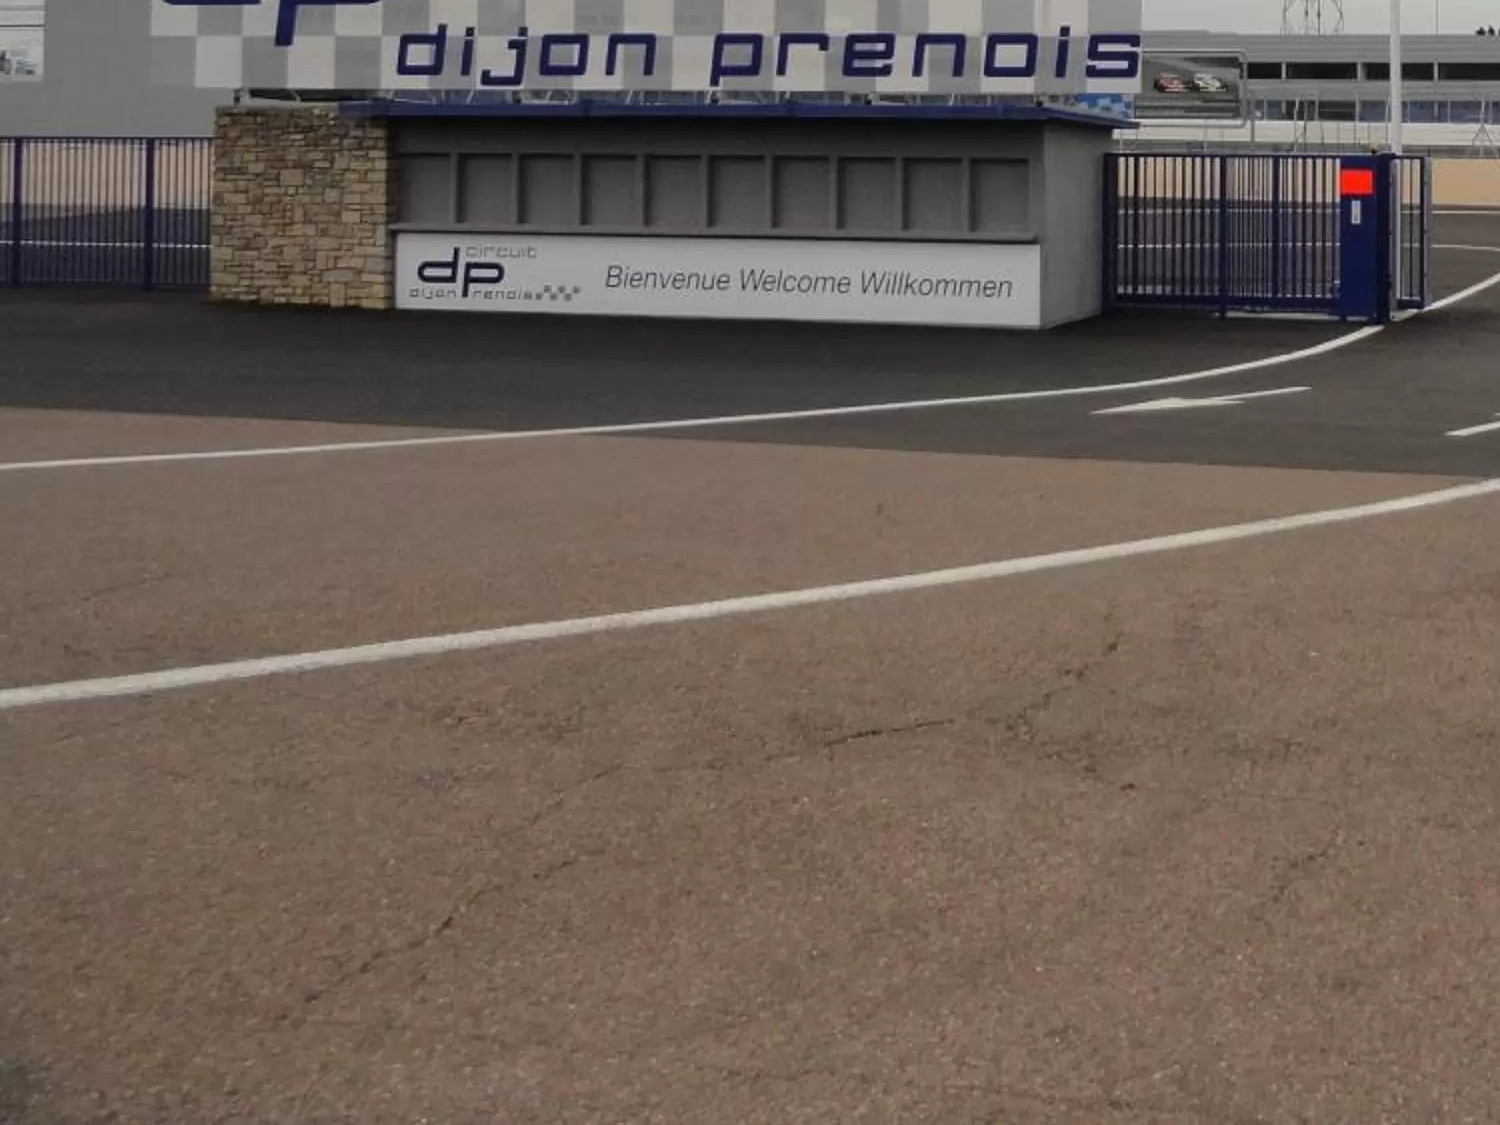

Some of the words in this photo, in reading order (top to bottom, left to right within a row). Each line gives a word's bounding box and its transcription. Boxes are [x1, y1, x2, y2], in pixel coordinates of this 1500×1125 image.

[396, 24, 657, 86] dijon
[709, 26, 1142, 87] prenois
[465, 245, 538, 259] circuit
[417, 246, 505, 298] dp
[604, 265, 730, 292] Bienvenue
[740, 268, 851, 295] Welcome
[860, 271, 1013, 299] Willkommen
[409, 286, 457, 300] dijon
